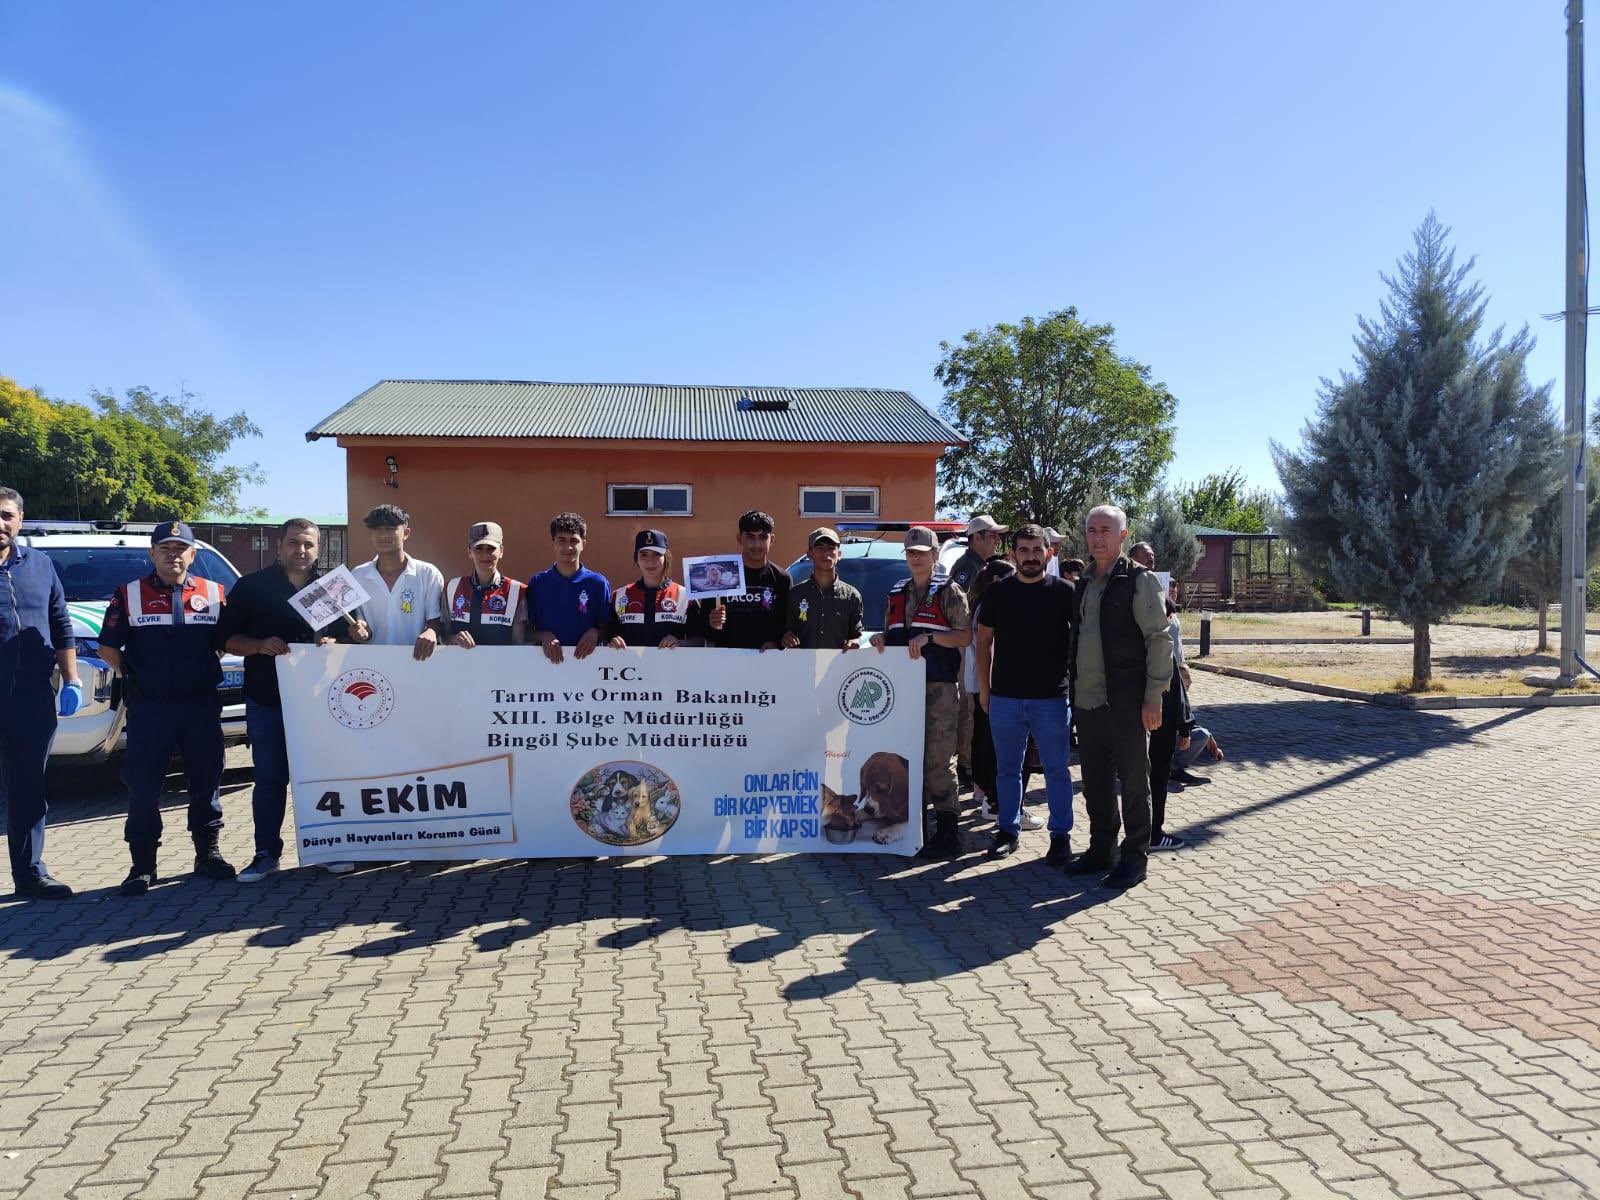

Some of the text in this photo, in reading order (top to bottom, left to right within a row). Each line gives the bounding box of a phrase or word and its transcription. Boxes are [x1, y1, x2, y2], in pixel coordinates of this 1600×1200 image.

[137, 615, 161, 624] ÇEVRE
[598, 666, 643, 681] T.C.
[490, 688, 777, 708] Tarım ve Orman Bakanlığı
[491, 710, 744, 729] XIII. Bölge Müdürlüğü
[487, 732, 748, 751] Bingöl Şube Müdürlüğü
[744, 768, 818, 795] ONLAR İÇİN
[315, 776, 468, 818] 4 EKİM
[714, 794, 818, 817] BİR KAP YEMEK
[302, 826, 501, 849] Dünya Hayvanları Koruma Günü
[744, 816, 818, 839] BİR KAP SU
